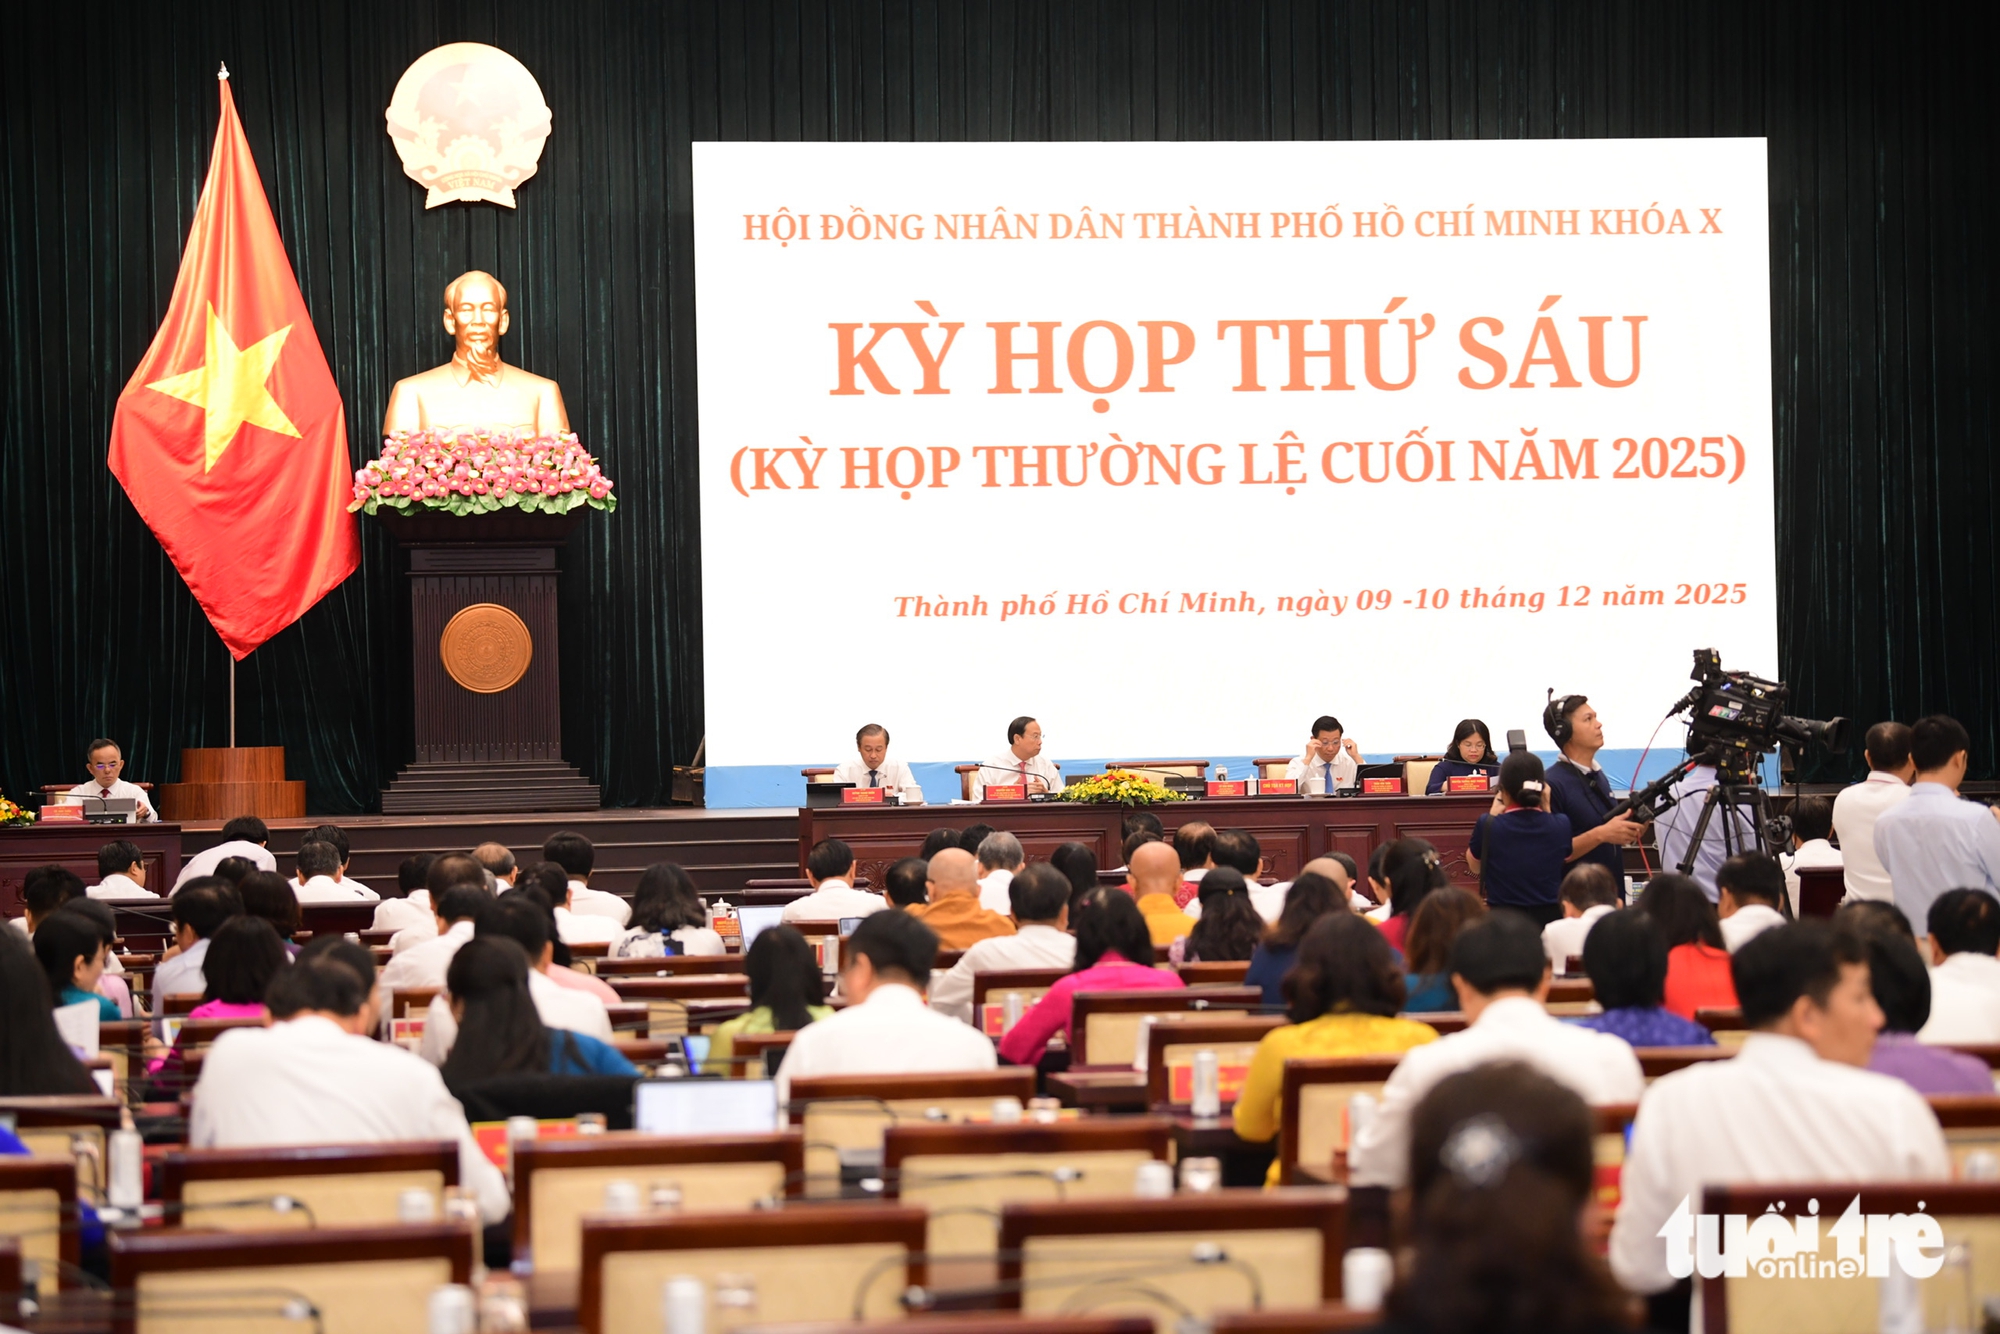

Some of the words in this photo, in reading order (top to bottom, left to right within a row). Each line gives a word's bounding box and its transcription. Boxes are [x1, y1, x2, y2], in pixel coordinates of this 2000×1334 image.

[473, 178, 495, 190] NAM
[743, 206, 811, 248] HỘI
[820, 204, 925, 241] ĐỒNG
[934, 205, 1040, 241] NHÂN
[1048, 205, 1126, 240] DÂN
[1134, 205, 1262, 240] THÀNH
[1270, 203, 1344, 239] PHỐ
[1353, 203, 1405, 239] HỒ
[1414, 203, 1475, 238] CHÍ
[1484, 209, 1581, 237] MINH
[1590, 201, 1692, 236] KHÓA
[1700, 207, 1723, 235] X
[827, 300, 966, 397] KỲ
[986, 320, 1197, 414] HỌP
[1217, 297, 1437, 393] THỨ
[1457, 295, 1649, 391] SÁU
[729, 436, 829, 498] (KỲ
[840, 446, 962, 500] HỌP
[972, 433, 1227, 489] THƯỜNG
[1238, 430, 1308, 496] LỆ
[1321, 426, 1457, 484] CUỐI
[1468, 427, 1601, 482] NĂM
[1612, 434, 1747, 485] 2025)
[893, 593, 989, 618] Thành
[1000, 590, 1059, 622] phố
[1065, 589, 1110, 615] Hồ
[1117, 590, 1171, 615] Chí
[1178, 591, 1266, 617] Minh,
[1277, 588, 1349, 618] ngày
[1355, 588, 1393, 611] 09
[1402, 587, 1450, 610] -10
[1459, 584, 1546, 614] tháng
[1557, 584, 1592, 607] 12
[1602, 583, 1665, 607] năm
[1673, 582, 1748, 605] 2025
[1710, 706, 1737, 718] HTV
